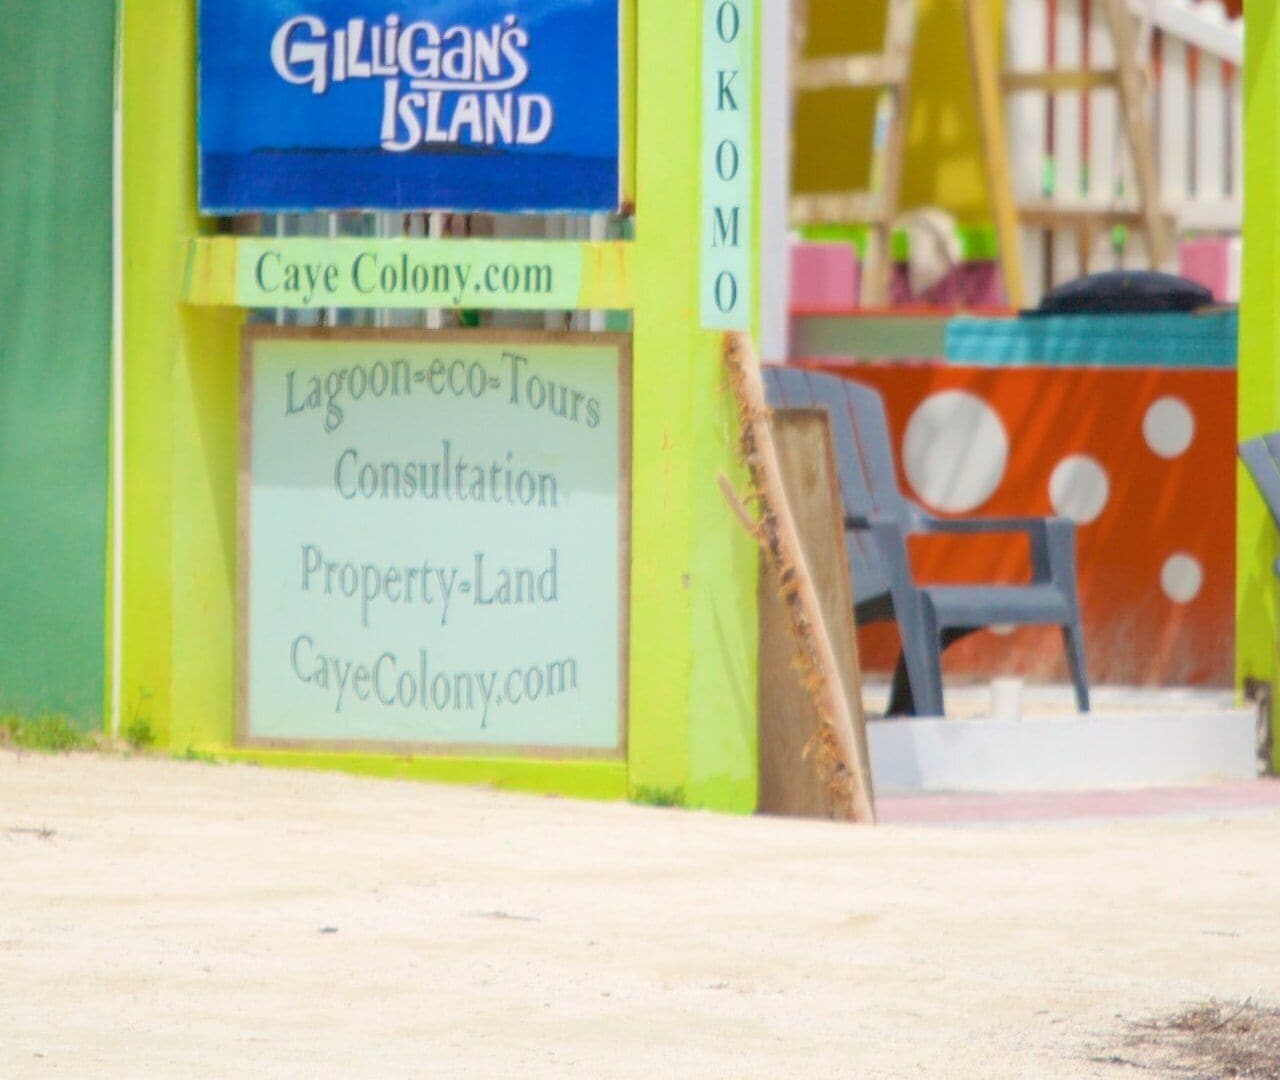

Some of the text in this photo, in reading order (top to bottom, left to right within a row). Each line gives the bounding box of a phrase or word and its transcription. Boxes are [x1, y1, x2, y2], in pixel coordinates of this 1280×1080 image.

[380, 79, 553, 151] ISLAND
[255, 250, 553, 304] Caye Colony.com
[334, 439, 560, 509] Consultation
[290, 633, 579, 728] CayeColony.com
